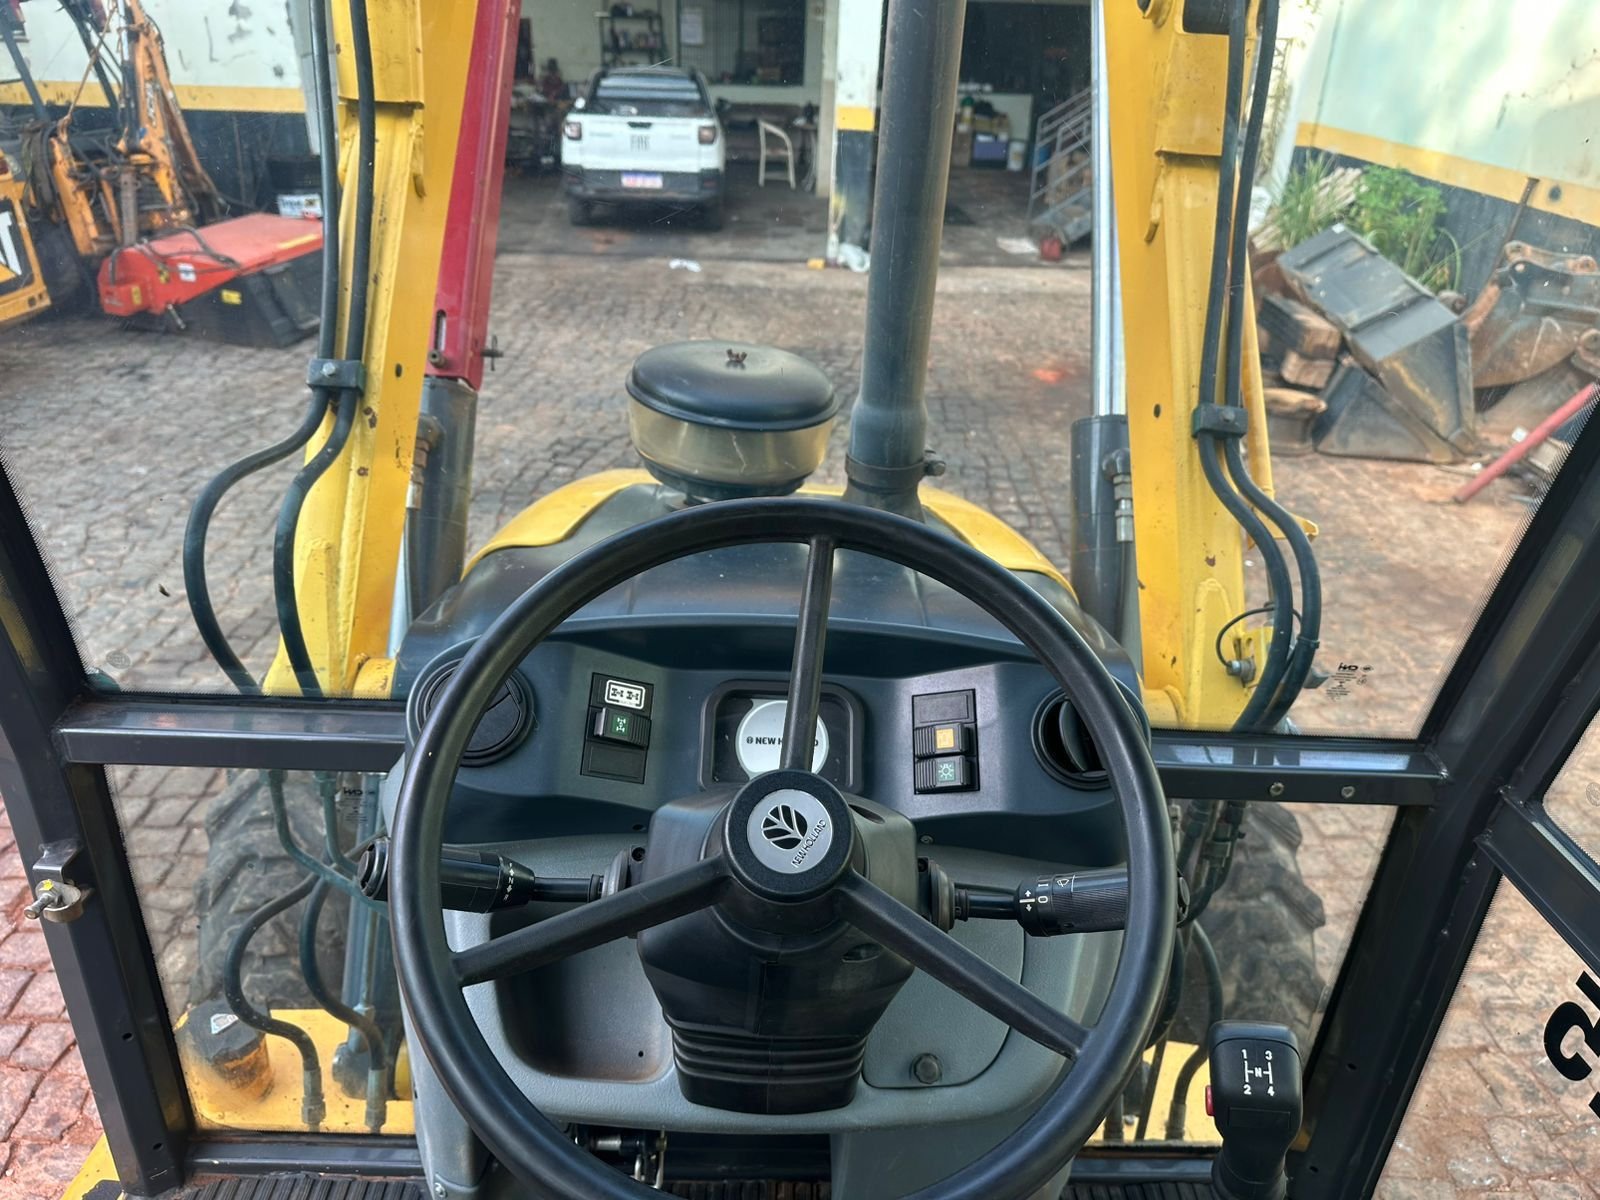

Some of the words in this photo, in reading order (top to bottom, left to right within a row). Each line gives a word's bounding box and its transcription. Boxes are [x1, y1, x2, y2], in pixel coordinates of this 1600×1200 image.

[755, 736, 777, 745] NEW
[1241, 1049, 1247, 1059] 1
[1265, 1050, 1273, 1060] 3
[1254, 1067, 1262, 1077] N
[1243, 1084, 1252, 1094] 2
[1267, 1086, 1275, 1096] 4
